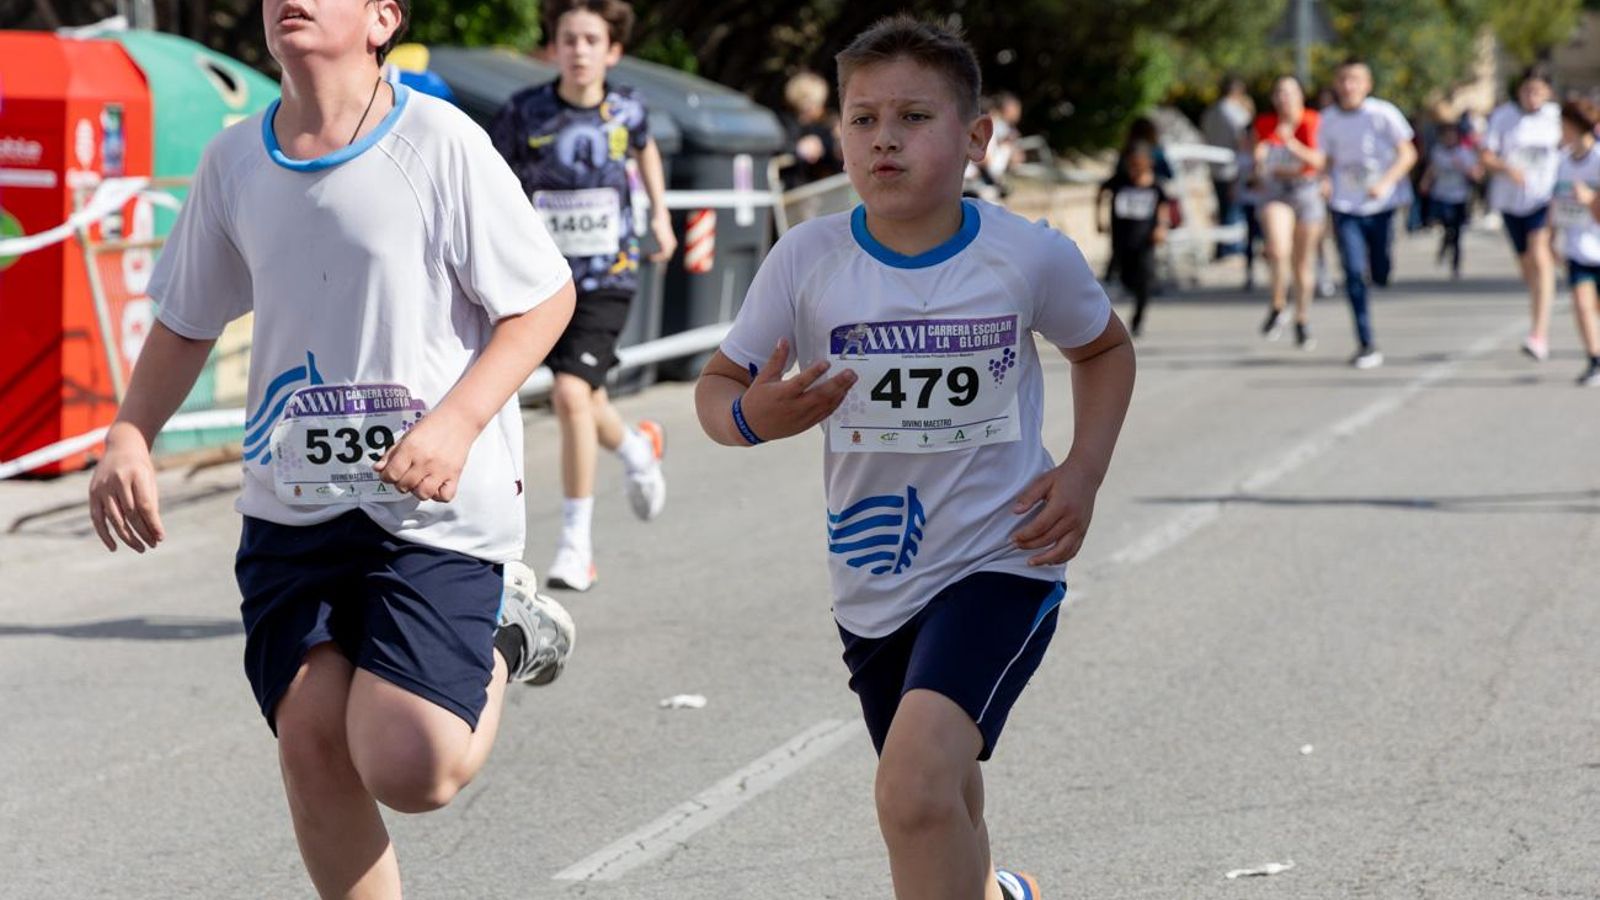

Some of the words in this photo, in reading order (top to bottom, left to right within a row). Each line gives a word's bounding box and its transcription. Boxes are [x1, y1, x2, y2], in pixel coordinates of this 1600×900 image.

[550, 214, 609, 232] 1404
[928, 324, 970, 336] CARRERA
[973, 321, 1012, 333] ESCOLAR
[864, 325, 925, 350] XXXVI
[936, 338, 950, 349] LA
[959, 333, 1000, 348] GLORIA
[870, 366, 979, 409] 479
[354, 399, 366, 410] LA
[374, 397, 411, 408] GLORIA
[902, 420, 922, 428] DIVINO
[923, 419, 952, 428] MAESTRO
[306, 425, 395, 465] 539
